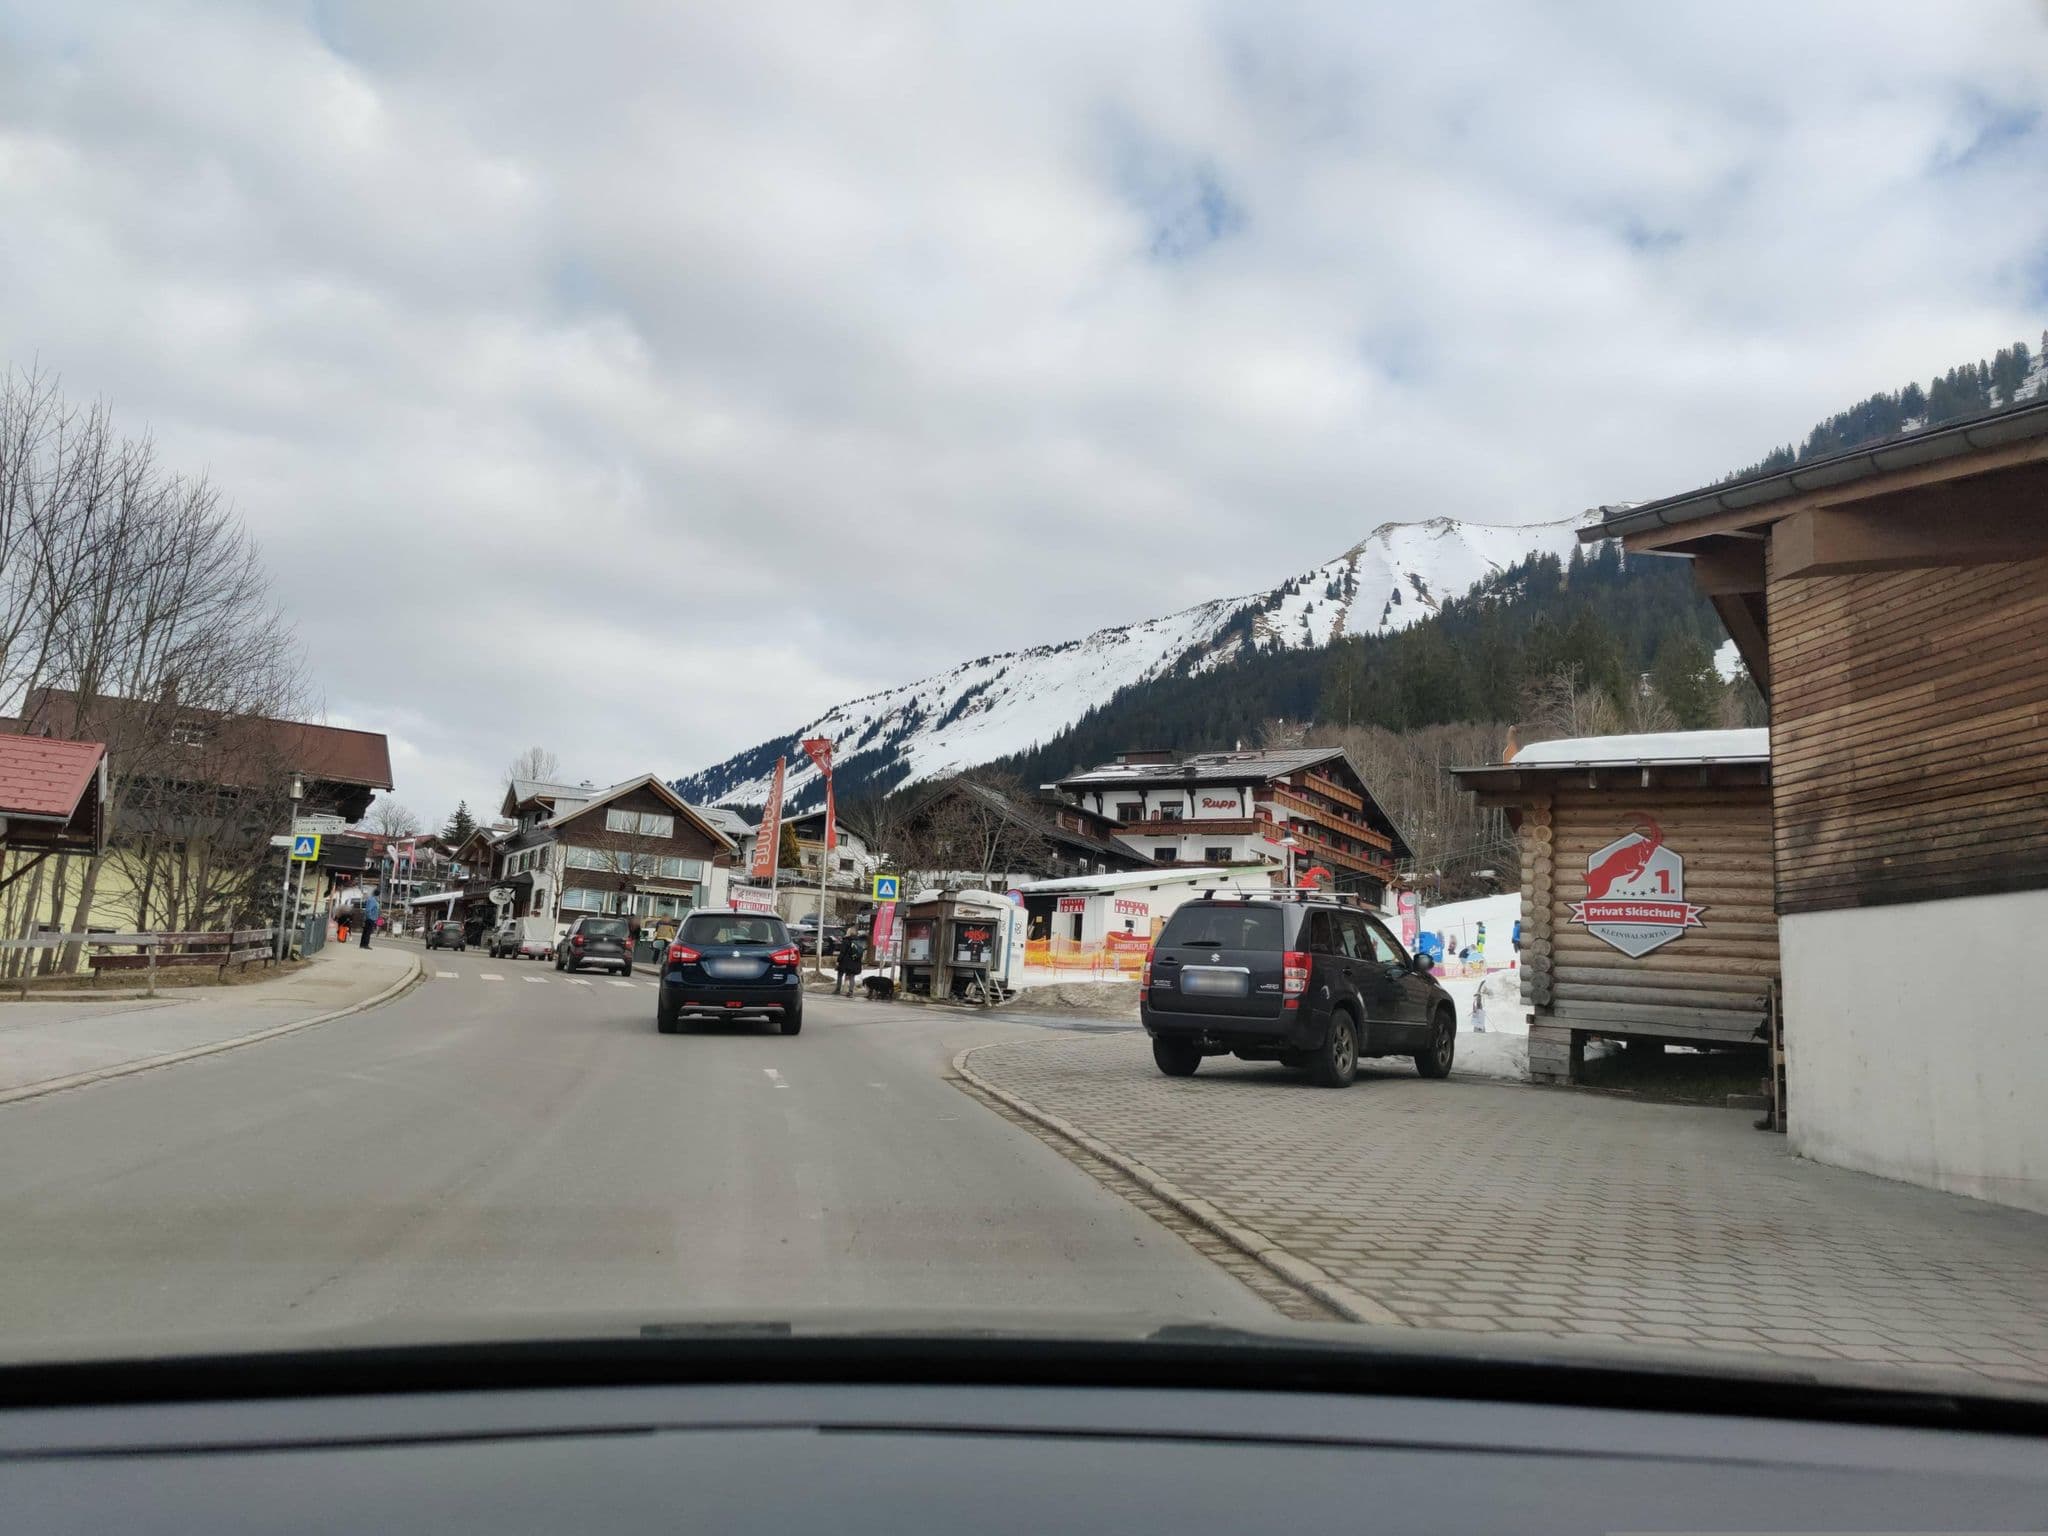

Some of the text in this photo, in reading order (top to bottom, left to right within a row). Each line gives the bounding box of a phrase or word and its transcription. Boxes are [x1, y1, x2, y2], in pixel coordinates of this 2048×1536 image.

[1202, 797, 1237, 810] Rupp
[1654, 869, 1675, 894] 1.
[1115, 904, 1148, 916] IDEAL
[1589, 907, 1681, 919] Privat Skischule
[1601, 927, 1669, 939] KLEINWALSERTAL
